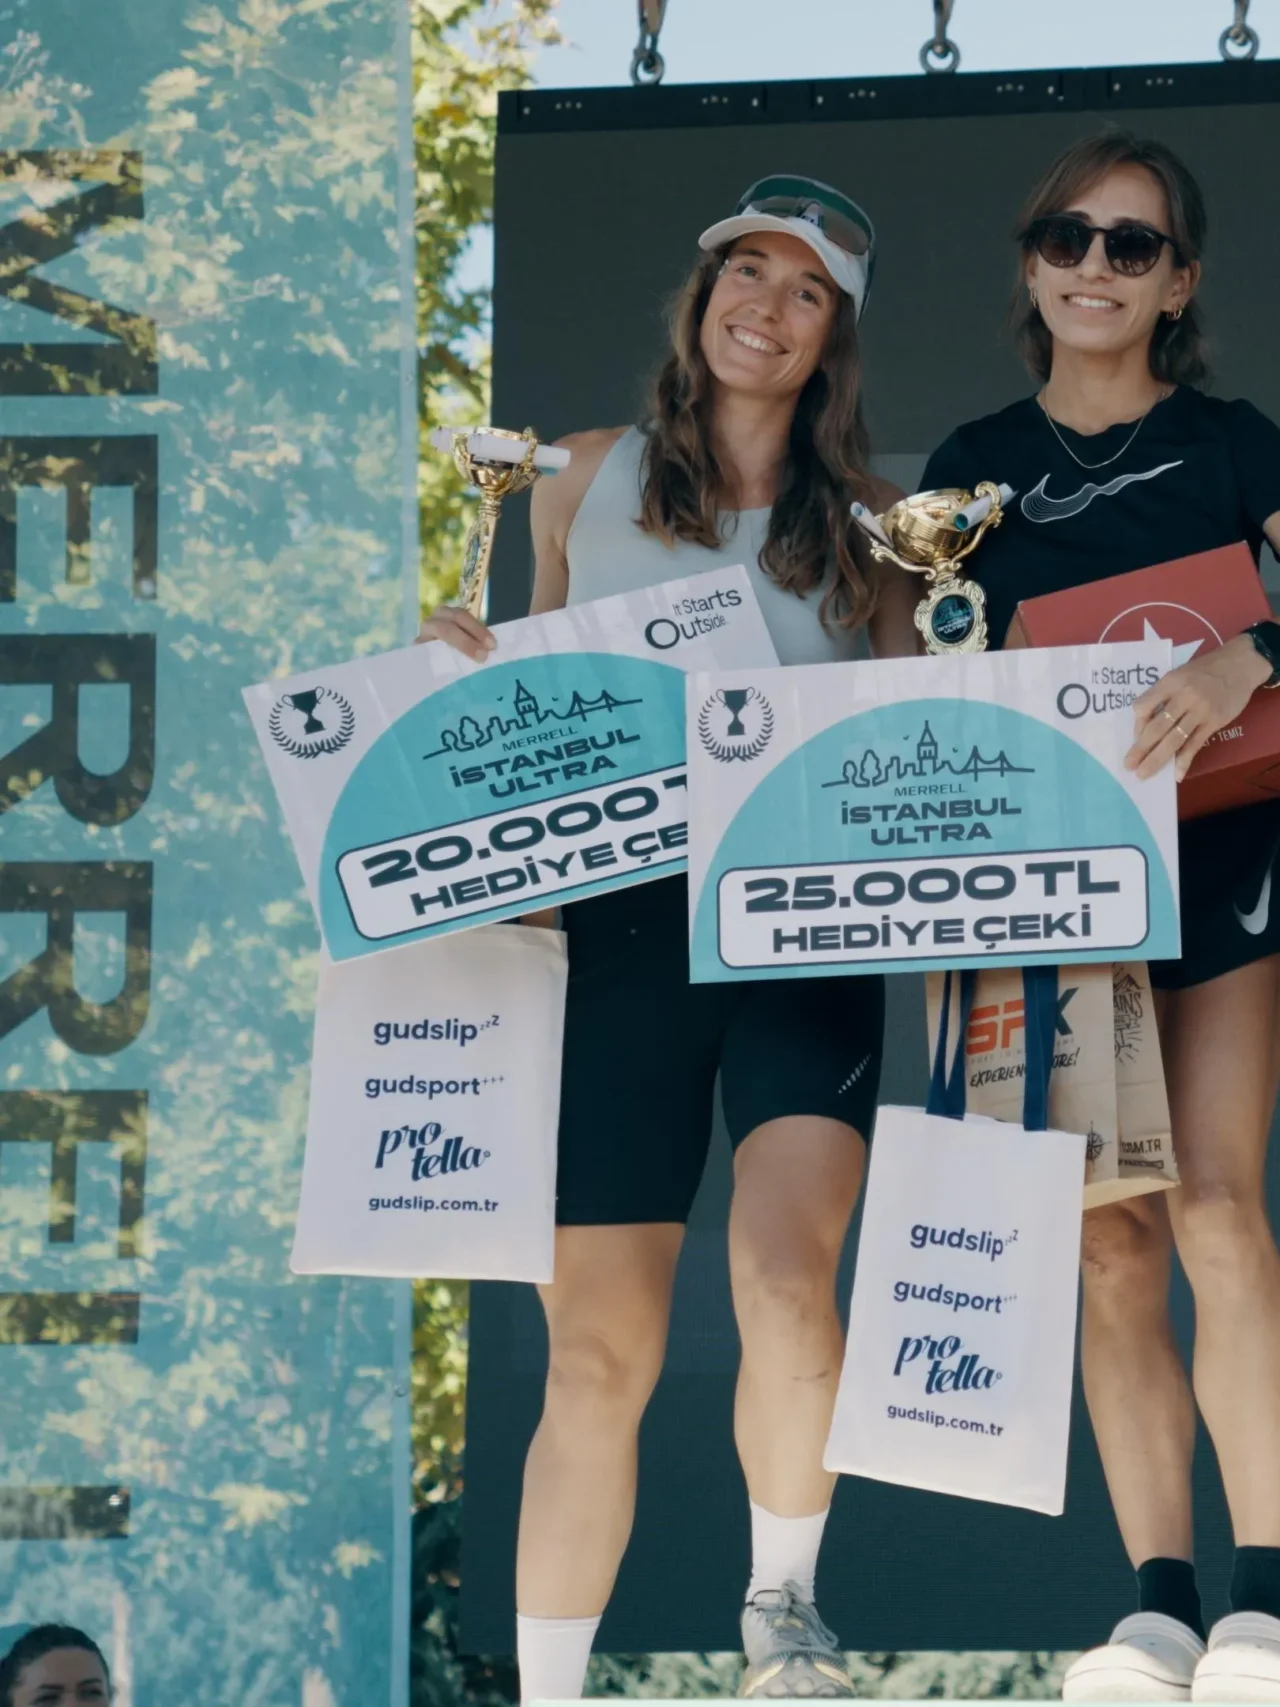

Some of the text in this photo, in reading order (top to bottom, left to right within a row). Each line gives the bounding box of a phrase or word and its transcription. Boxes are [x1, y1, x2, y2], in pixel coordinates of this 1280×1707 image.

[682, 589, 742, 614] Starts
[644, 613, 727, 650] Outside
[1101, 664, 1160, 685] Starts
[449, 729, 640, 787] İSTANBUL
[502, 726, 578, 752] MERRELL
[489, 755, 617, 798] ULTRA
[893, 783, 967, 797] MERRELL
[840, 797, 1022, 825] İSTANBUL
[361, 786, 660, 888] 20.000
[871, 822, 992, 846] ULTRA
[410, 821, 689, 916] HEDİYE ÇE
[744, 860, 1120, 914] 25.000 TL
[772, 904, 1092, 954] HEDİYE ÇEKİ
[970, 1063, 1025, 1088] EXPERIEN
[374, 1122, 445, 1169] pro
[411, 1136, 484, 1182] tella
[369, 1196, 500, 1213] gudslip.com.tr
[893, 1335, 962, 1376] pro
[925, 1354, 996, 1395] tella
[887, 1404, 1004, 1437] gudslip.com.tr
